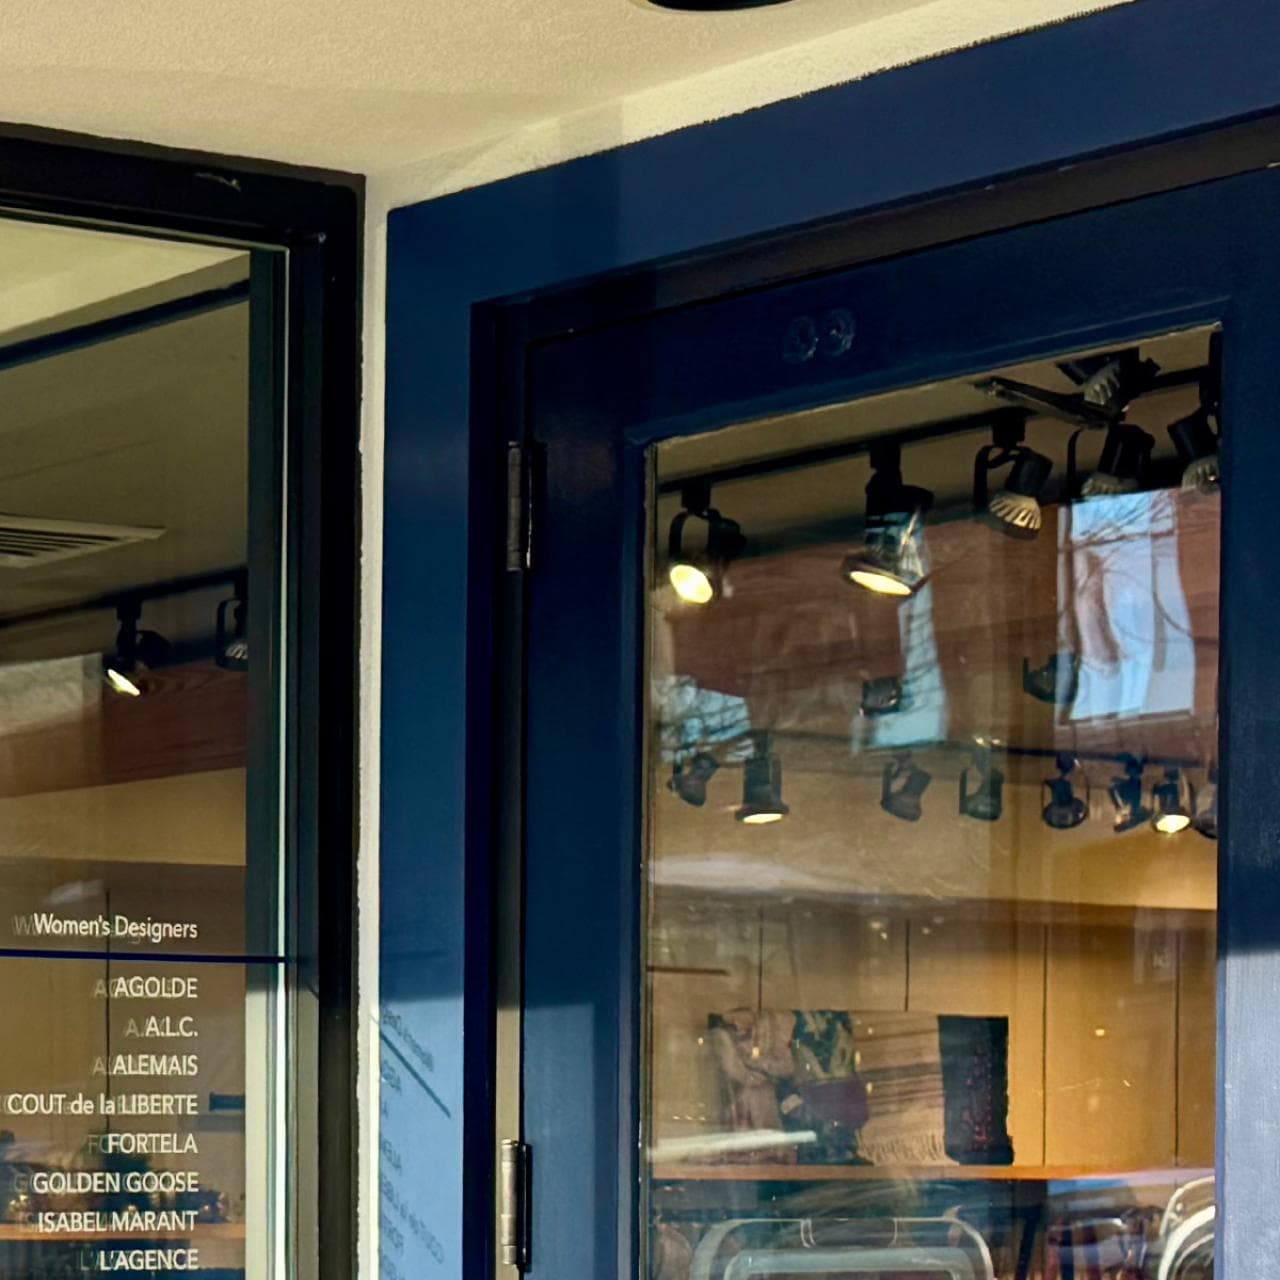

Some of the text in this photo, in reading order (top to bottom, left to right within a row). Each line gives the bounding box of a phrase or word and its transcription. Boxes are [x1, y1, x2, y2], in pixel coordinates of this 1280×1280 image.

[34, 912, 198, 942] Women's Designers
[114, 978, 198, 998] AGOLDE
[145, 1016, 198, 1037] A.L.C.
[113, 1055, 198, 1076] ALEMAIS
[7, 1094, 198, 1115] COUT de la LIBERTE
[108, 1133, 198, 1154] FORTELA
[33, 1172, 199, 1193] GOLDEN GOOSE
[38, 1210, 197, 1233] ISABEL MARANT
[99, 1248, 199, 1270] L'AGENCE
